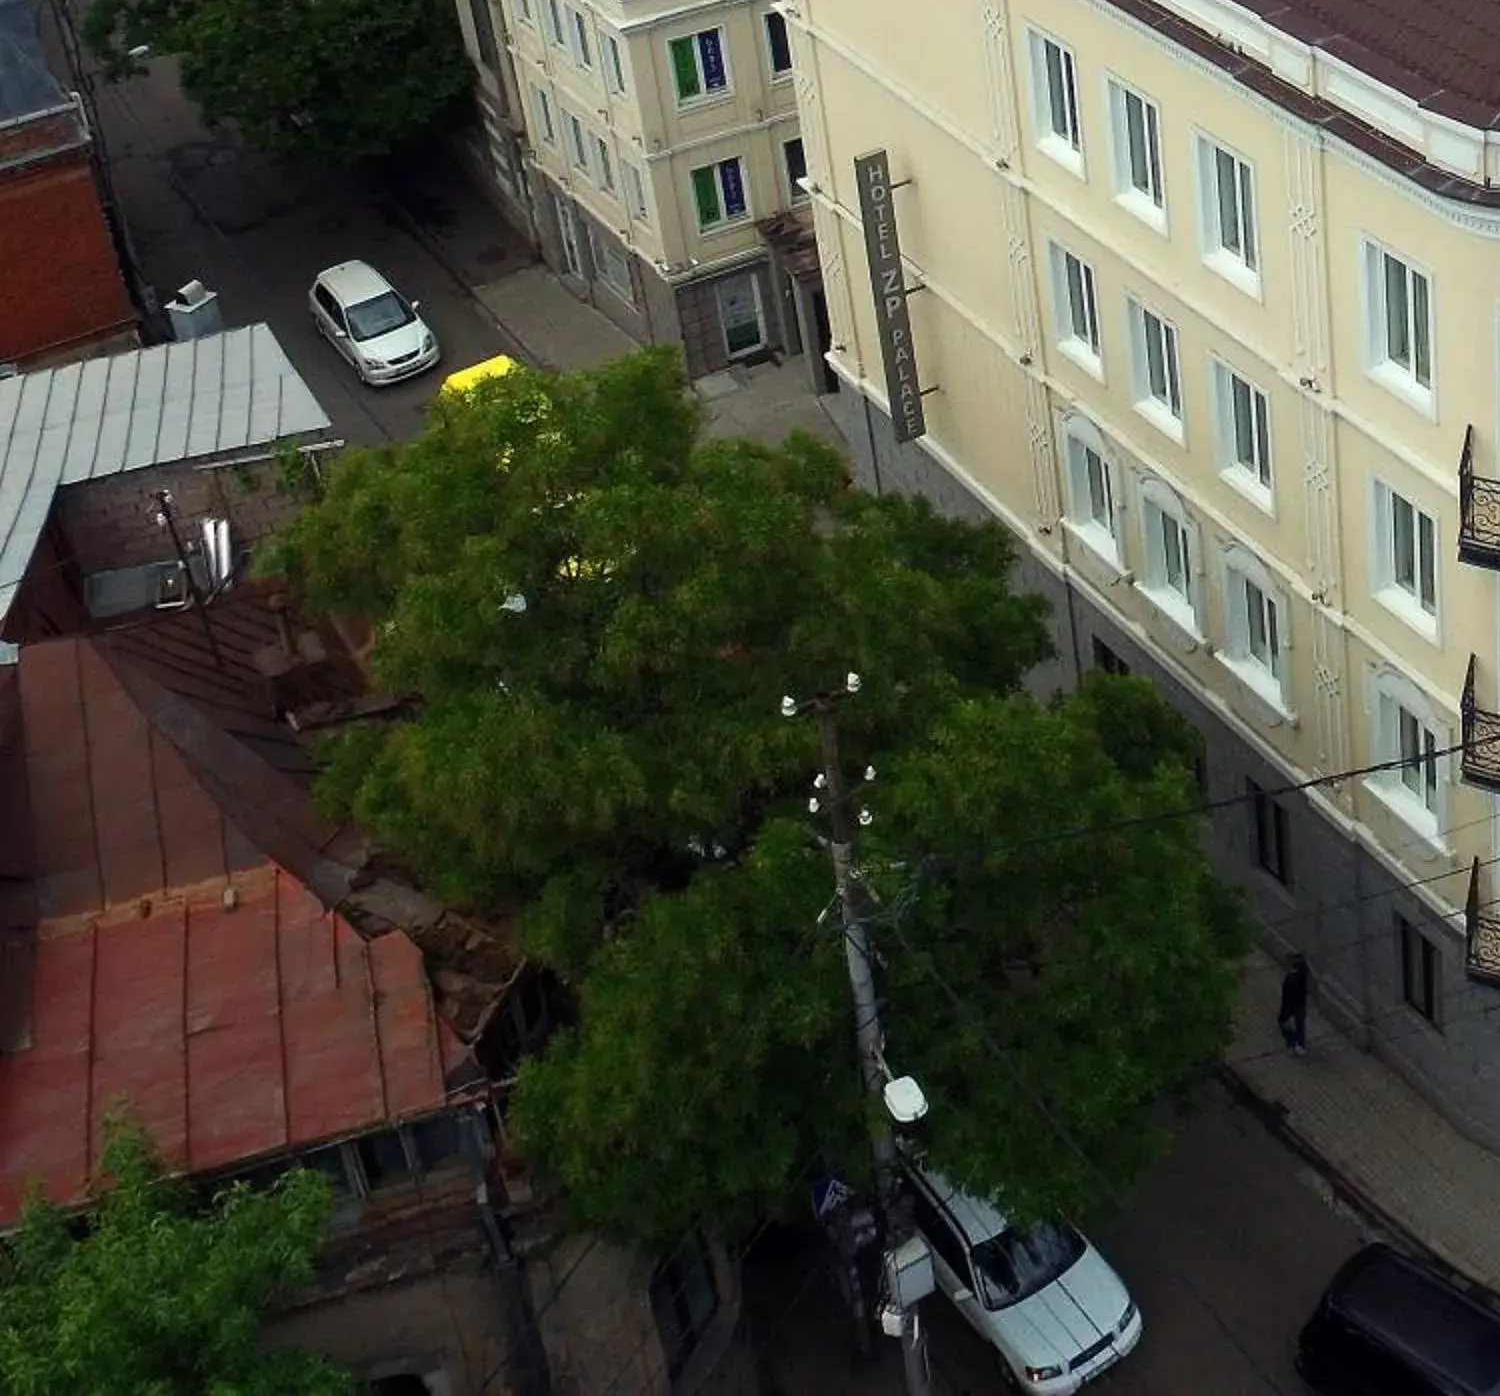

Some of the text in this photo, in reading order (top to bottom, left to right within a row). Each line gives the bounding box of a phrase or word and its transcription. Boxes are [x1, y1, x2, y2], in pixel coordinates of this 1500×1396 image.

[868, 164, 917, 434] HOTEL ZP PALACE
